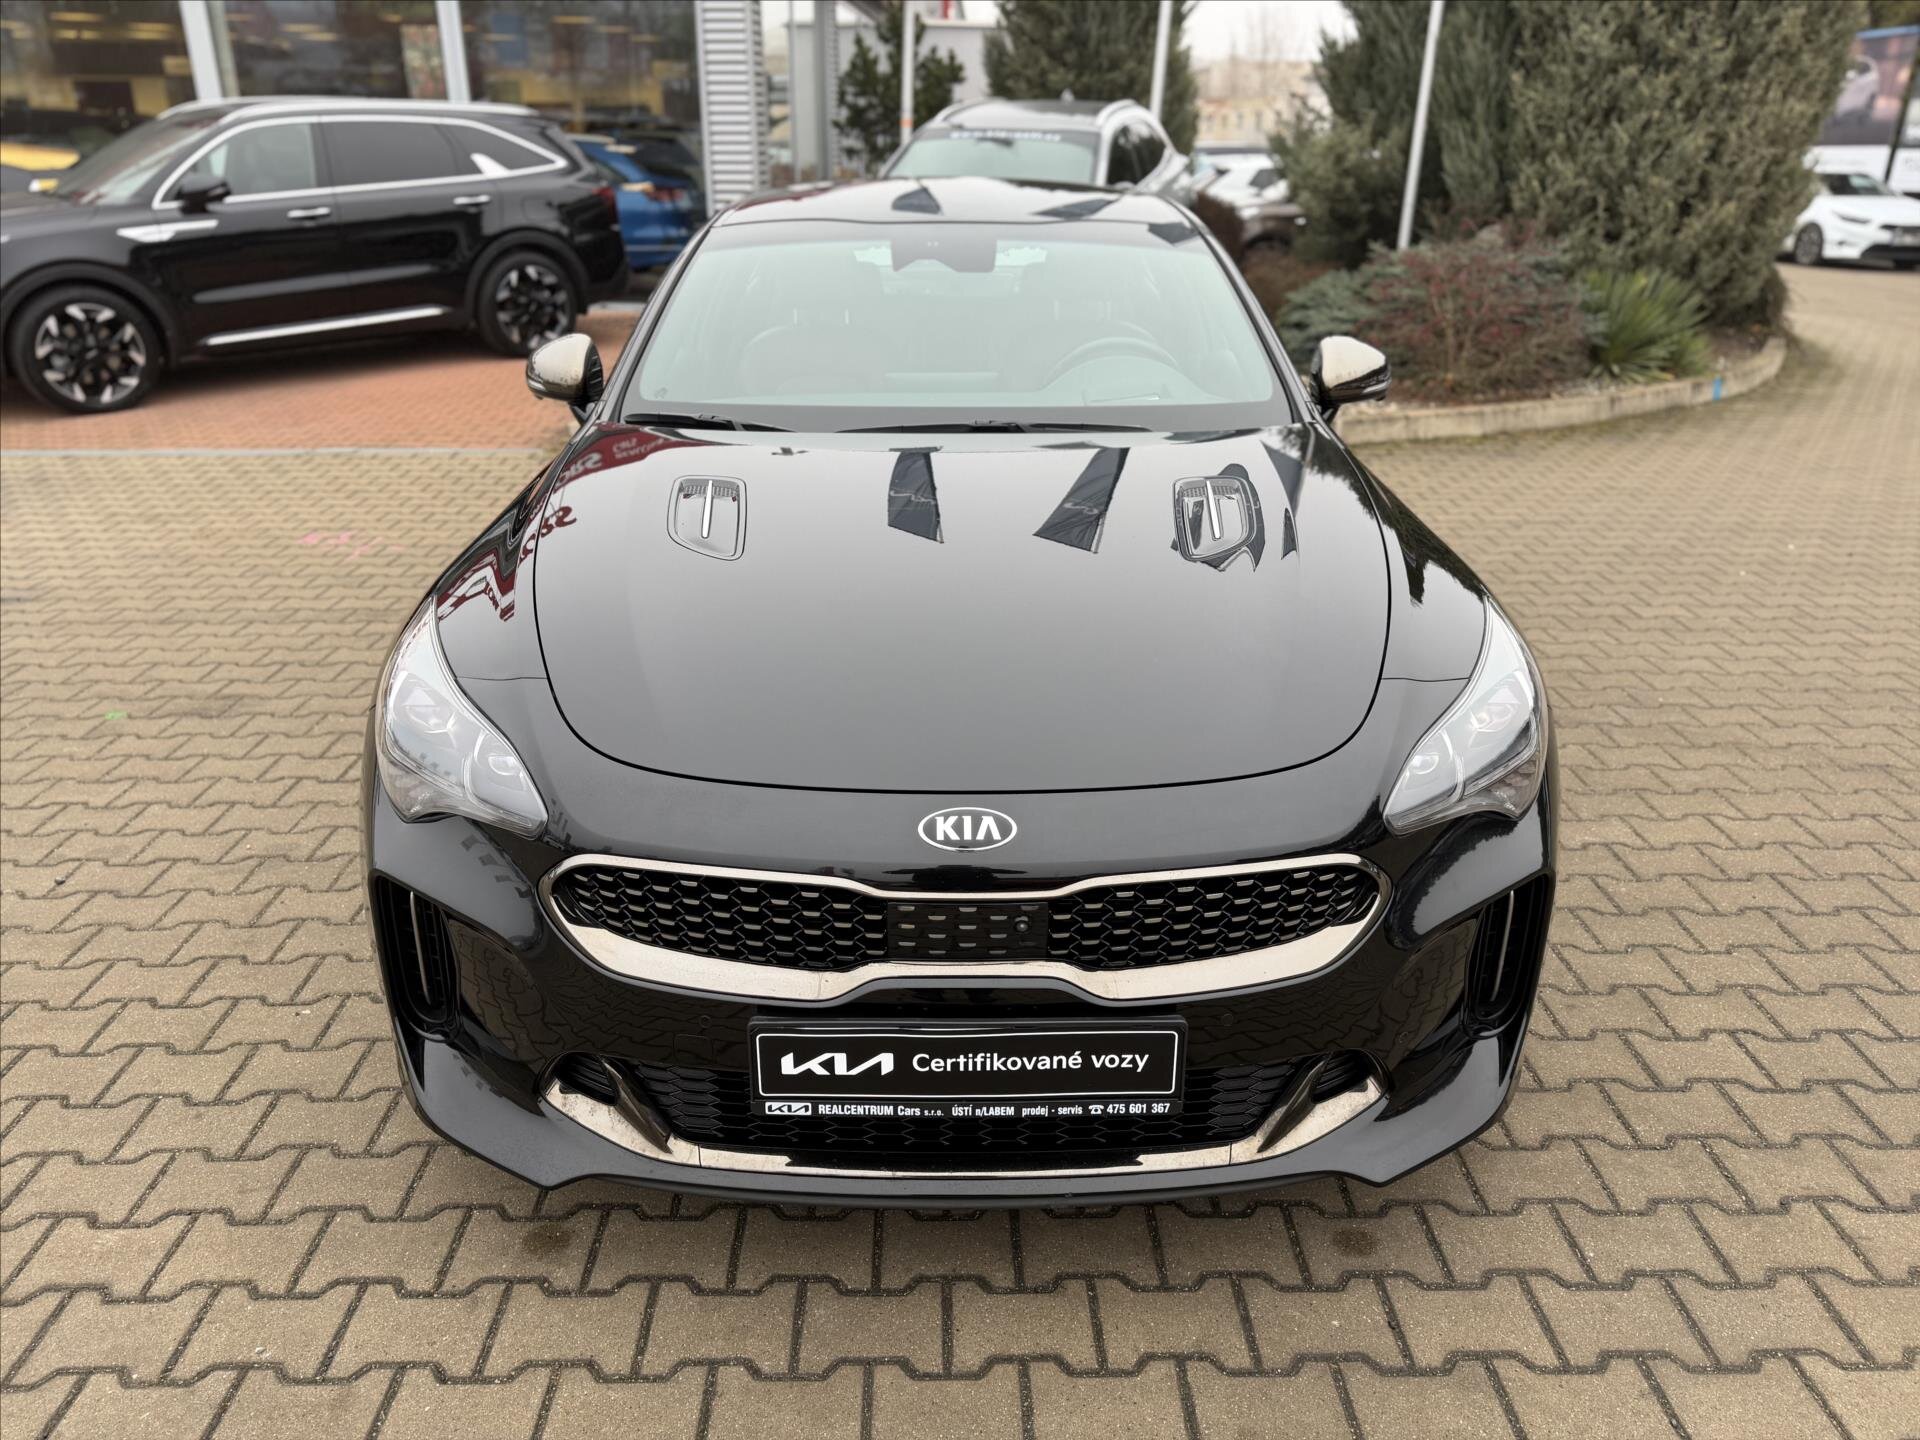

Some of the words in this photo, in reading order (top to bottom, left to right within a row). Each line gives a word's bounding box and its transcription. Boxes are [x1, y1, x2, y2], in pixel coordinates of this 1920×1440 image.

[934, 815, 1002, 841] KIA
[911, 1050, 1083, 1073] Certifikované
[1090, 1051, 1150, 1073] vozy
[818, 1104, 894, 1116] REALCENTRUM
[897, 1106, 921, 1116] Cars
[924, 1109, 945, 1117] s.r.o.
[952, 1104, 973, 1116] ÚSTÍ
[975, 1106, 1015, 1117] n/LABEM
[1021, 1105, 1049, 1117] prodej
[1057, 1104, 1083, 1115] servis
[1106, 1103, 1126, 1114] 475
[1129, 1103, 1147, 1114] 601
[1151, 1102, 1171, 1114] 367
